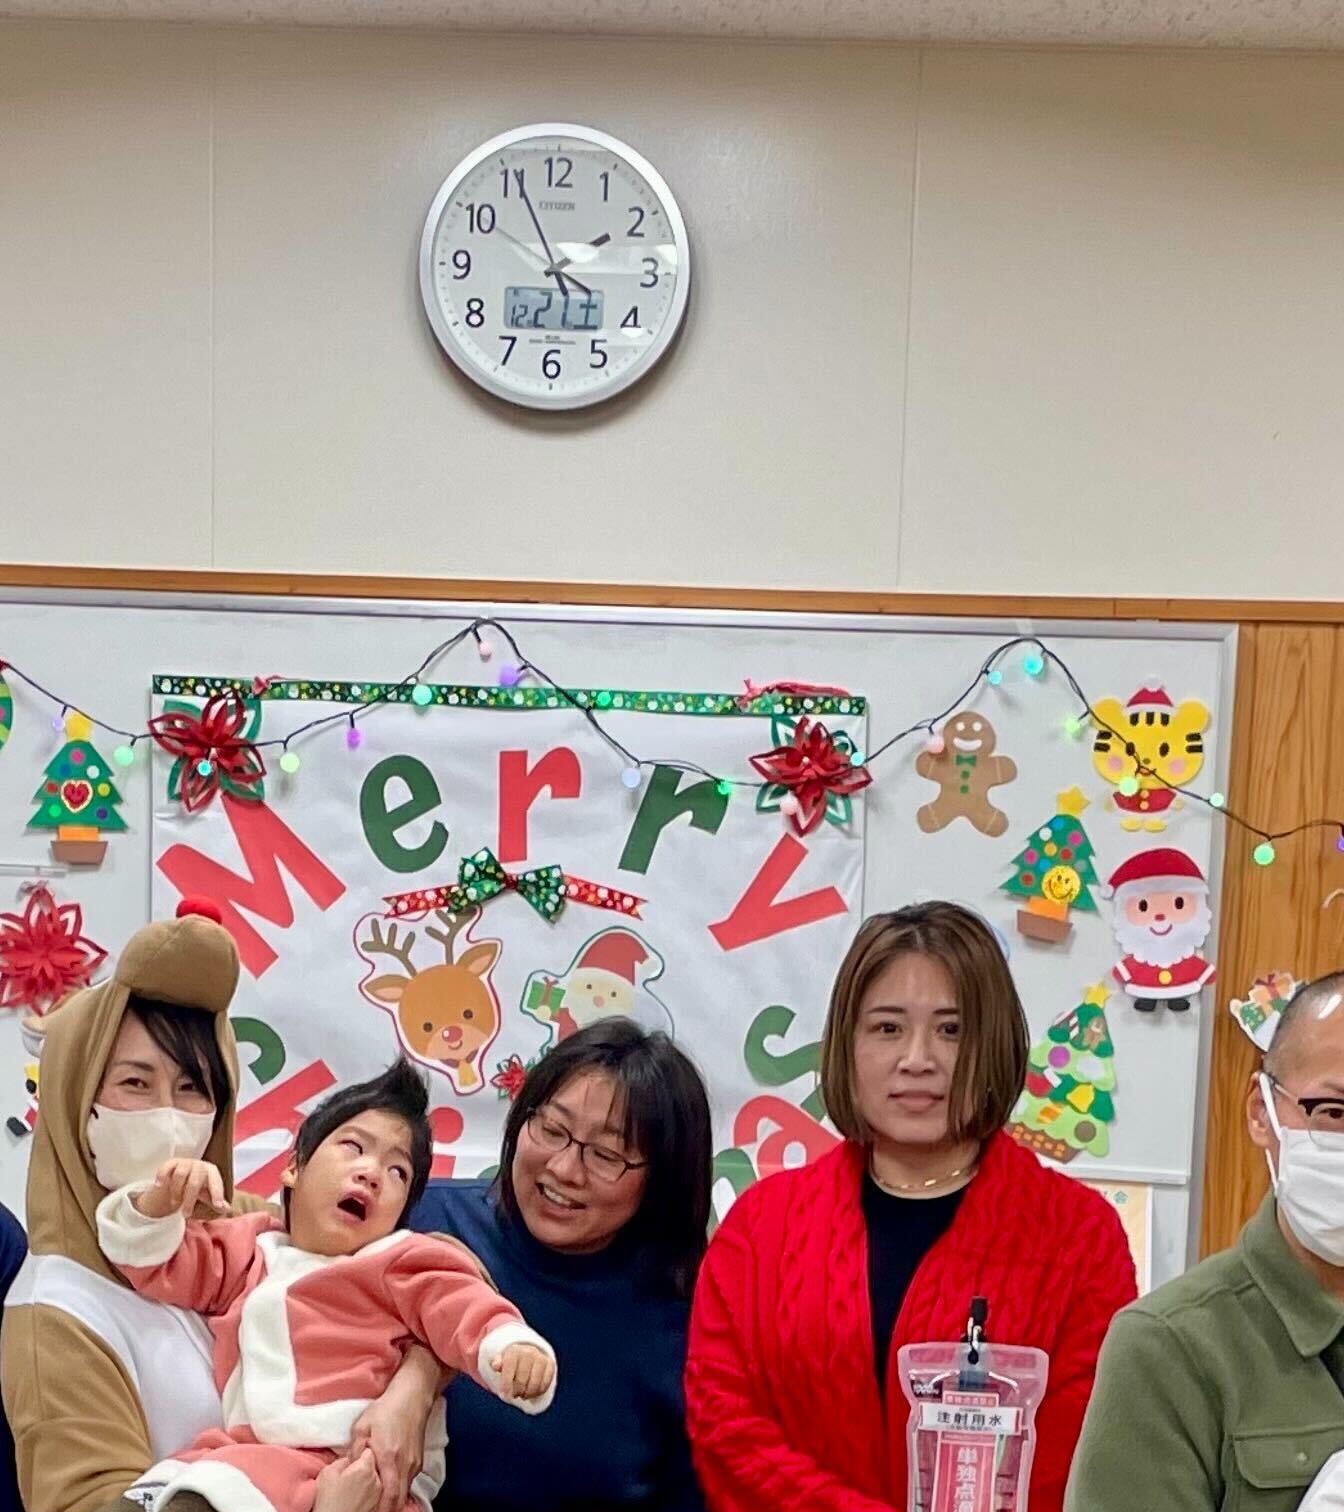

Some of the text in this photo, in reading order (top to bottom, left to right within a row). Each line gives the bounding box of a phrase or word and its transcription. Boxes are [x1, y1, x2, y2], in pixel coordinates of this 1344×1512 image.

[500, 168, 525, 199] 11
[544, 157, 573, 188] 12
[599, 171, 609, 202] 1
[465, 203, 496, 234] 10
[626, 206, 645, 238] 2
[452, 250, 472, 280] 9
[639, 257, 659, 288] 3
[465, 297, 485, 328] 8
[620, 305, 642, 333] 4
[499, 336, 517, 366] 7
[542, 349, 561, 379] 6
[589, 339, 608, 369] 5
[156, 747, 848, 980] Merry
